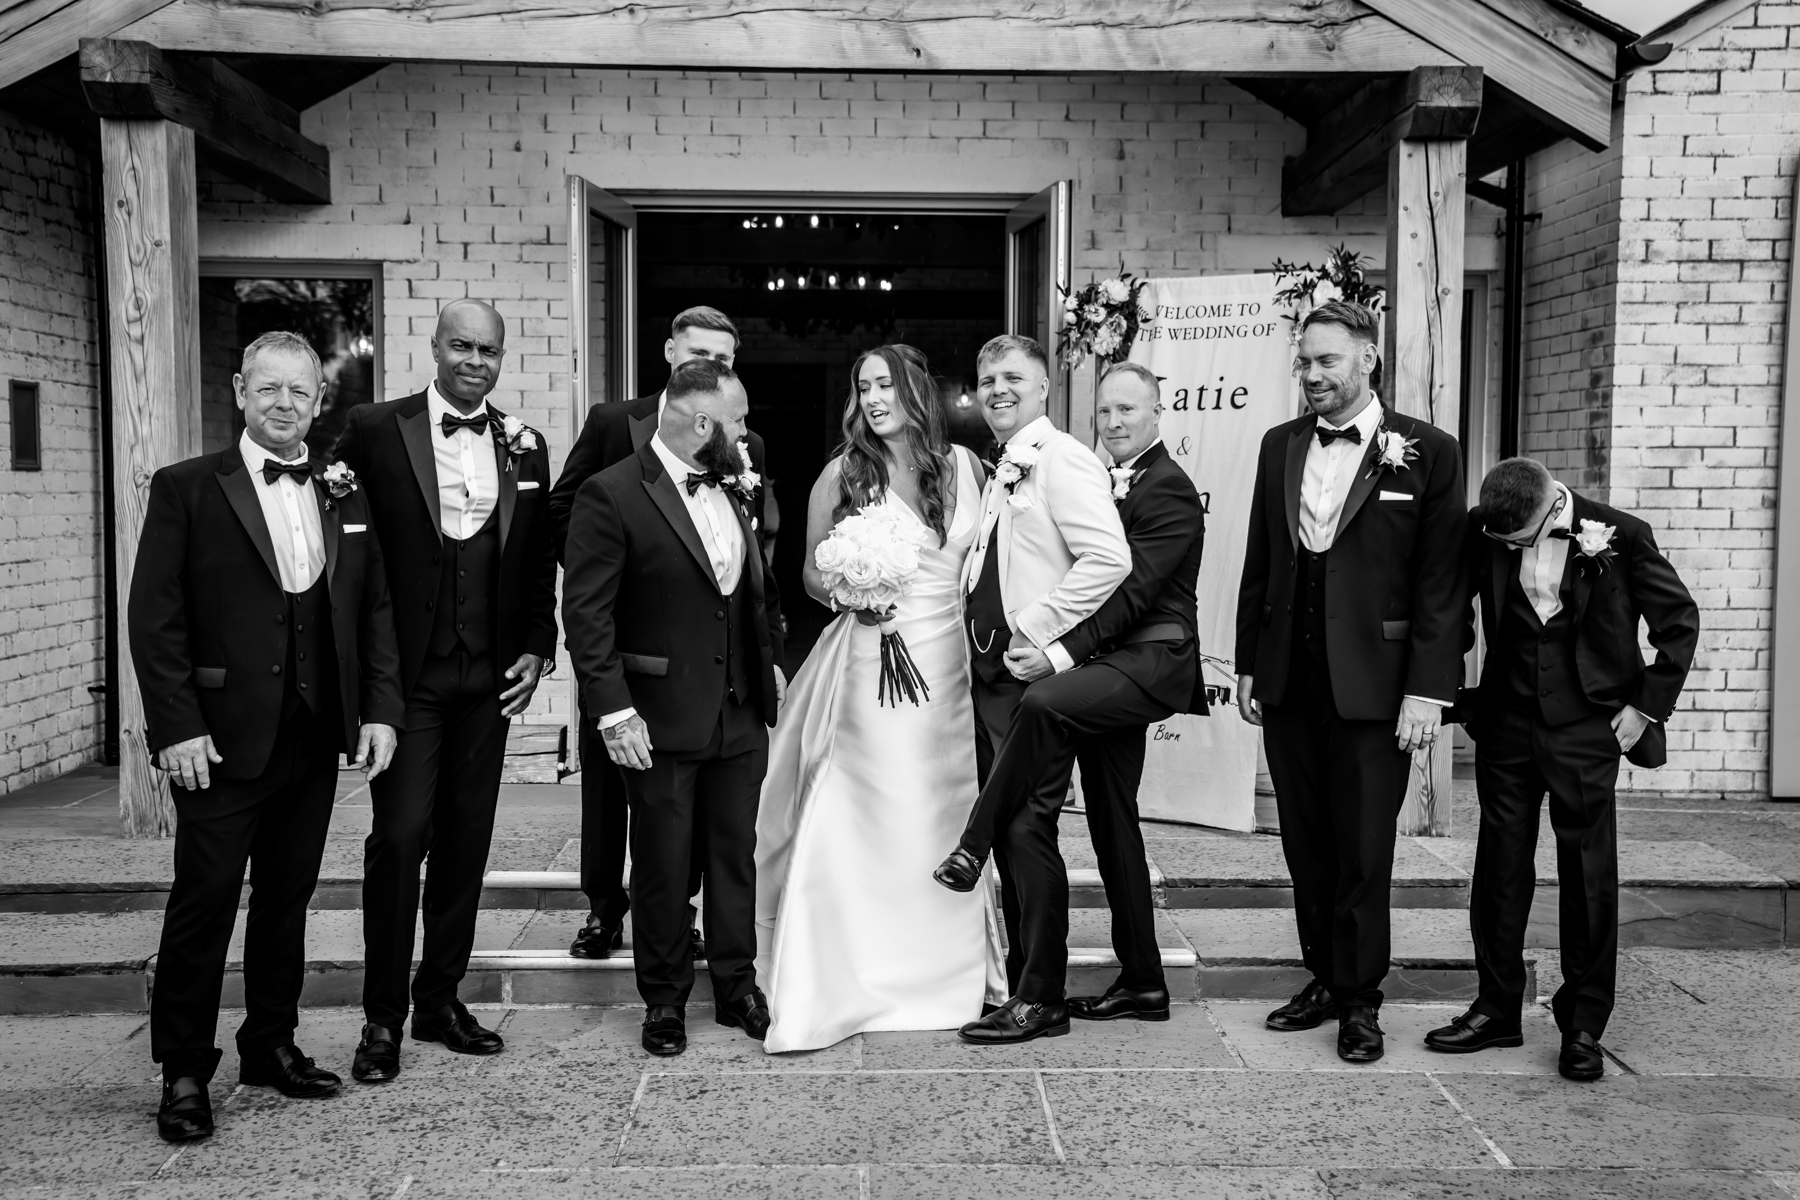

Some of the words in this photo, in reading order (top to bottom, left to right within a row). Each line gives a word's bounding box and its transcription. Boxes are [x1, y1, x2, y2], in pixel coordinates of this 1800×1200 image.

[1237, 302, 1261, 317] TO
[1167, 324, 1248, 341] WEDDING
[1252, 322, 1277, 338] OF
[1155, 376, 1249, 412] atie
[1176, 435, 1192, 456] &
[1153, 723, 1181, 742] Barn
